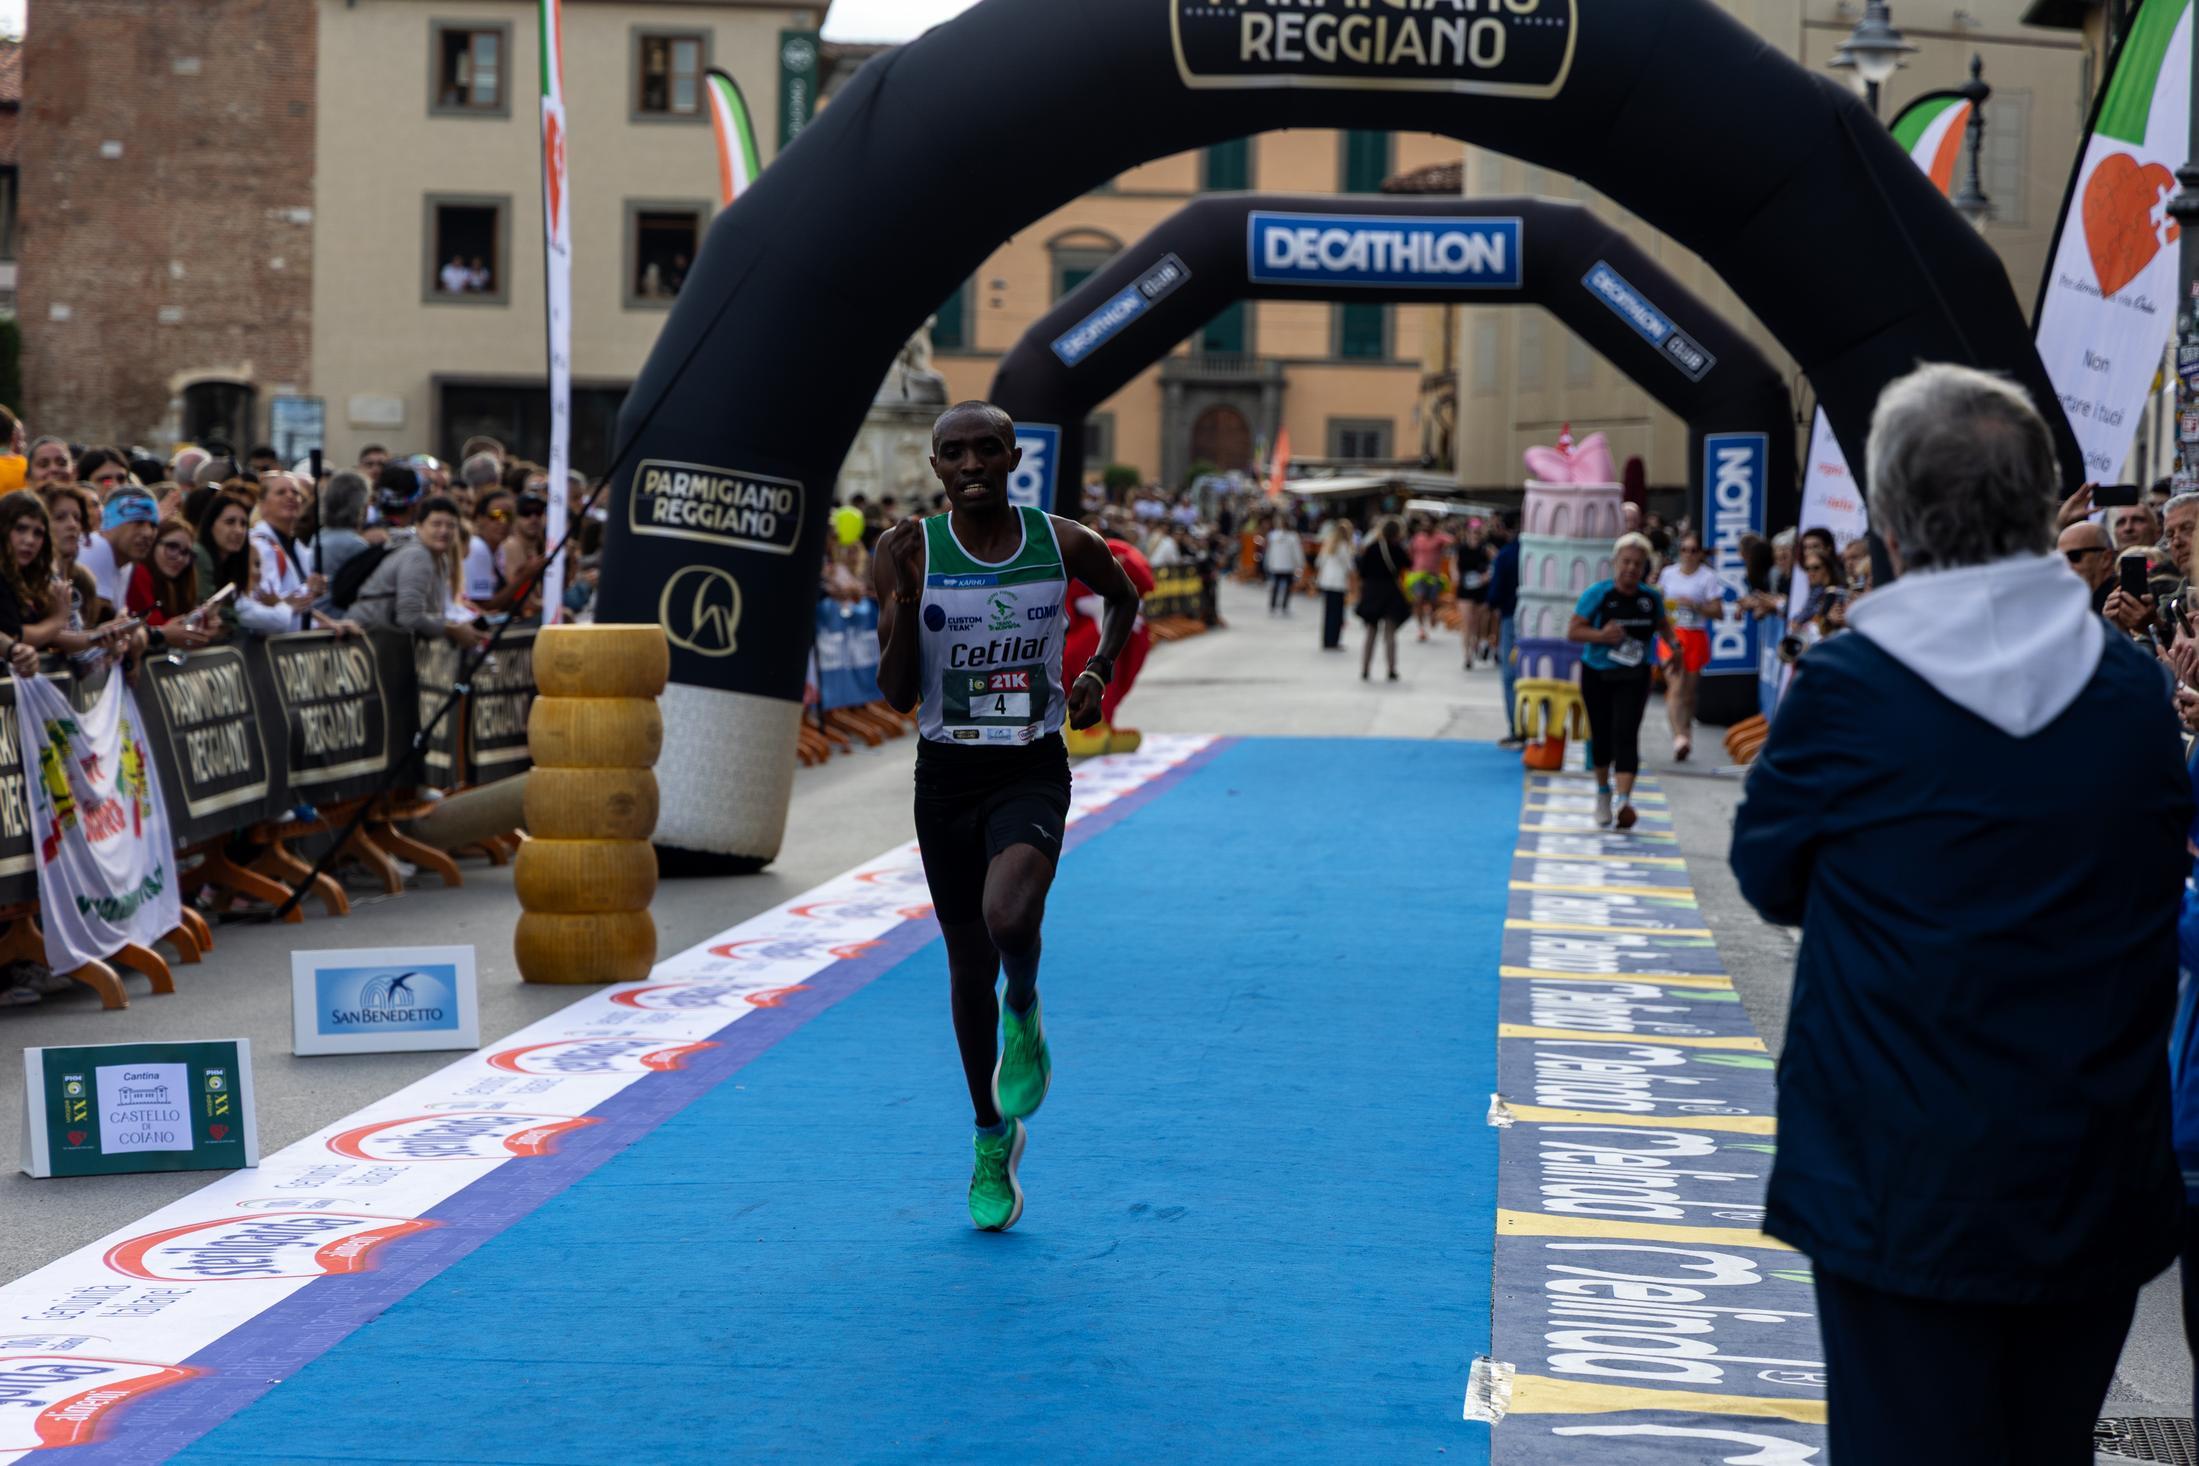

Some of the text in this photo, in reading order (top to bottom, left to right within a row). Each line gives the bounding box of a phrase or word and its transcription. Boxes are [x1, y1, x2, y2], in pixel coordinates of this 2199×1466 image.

[1240, 12, 1507, 69] REGGIANO
[1263, 225, 1507, 275] DECATHLON
[2082, 348, 2112, 374] Non
[644, 469, 793, 515] PARMIGIANO
[652, 497, 776, 539] REGGIANO
[958, 578, 986, 587] KARHU
[947, 616, 983, 625] CUSTOM
[277, 644, 373, 698] PARMIGIANO
[950, 636, 1049, 668] Cetilar
[160, 661, 248, 726] PARMIGIANO
[991, 672, 1028, 689] 21K
[994, 694, 1007, 715] 4
[299, 699, 366, 754] REGGIANO
[186, 720, 250, 784] REGGIANO
[123, 1071, 160, 1081] Cantina
[1533, 1040, 1728, 1112] Melinda
[109, 1109, 181, 1124] CASTELLO
[141, 1123, 151, 1131] DI
[118, 1131, 175, 1145] COIANO
[1538, 1125, 1767, 1220] Melinda
[161, 1217, 366, 1277] sterilgarda
[21, 1284, 132, 1321] Genuinità
[1543, 1242, 1828, 1386] Melinda
[44, 1390, 131, 1422] alimenti
